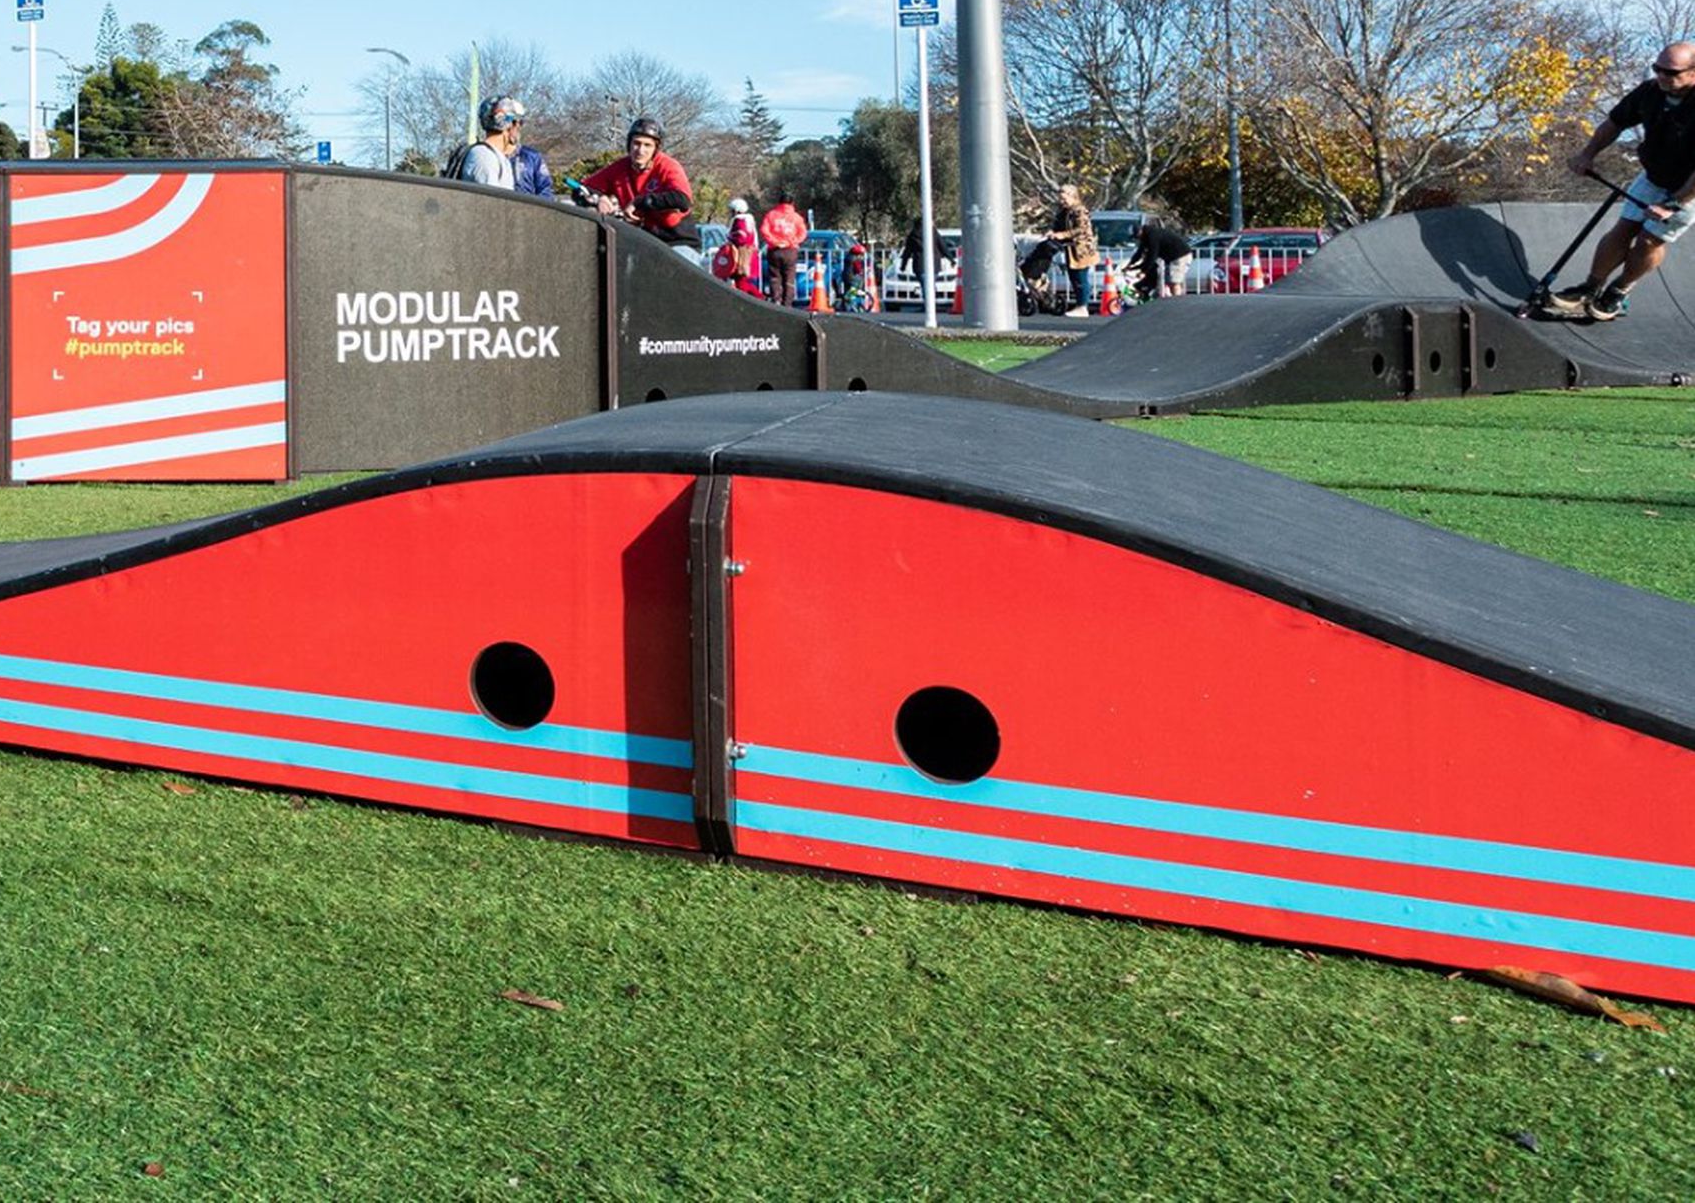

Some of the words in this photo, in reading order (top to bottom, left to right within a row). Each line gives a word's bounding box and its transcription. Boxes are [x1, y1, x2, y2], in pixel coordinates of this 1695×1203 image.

[336, 289, 520, 326] MODULAR
[66, 316, 101, 338] Tag
[106, 320, 150, 338] your
[155, 316, 195, 337] pics
[65, 336, 185, 360] #pumptrack
[337, 324, 561, 364] PUMPTRACK
[639, 333, 780, 357] #communitypumptrack
